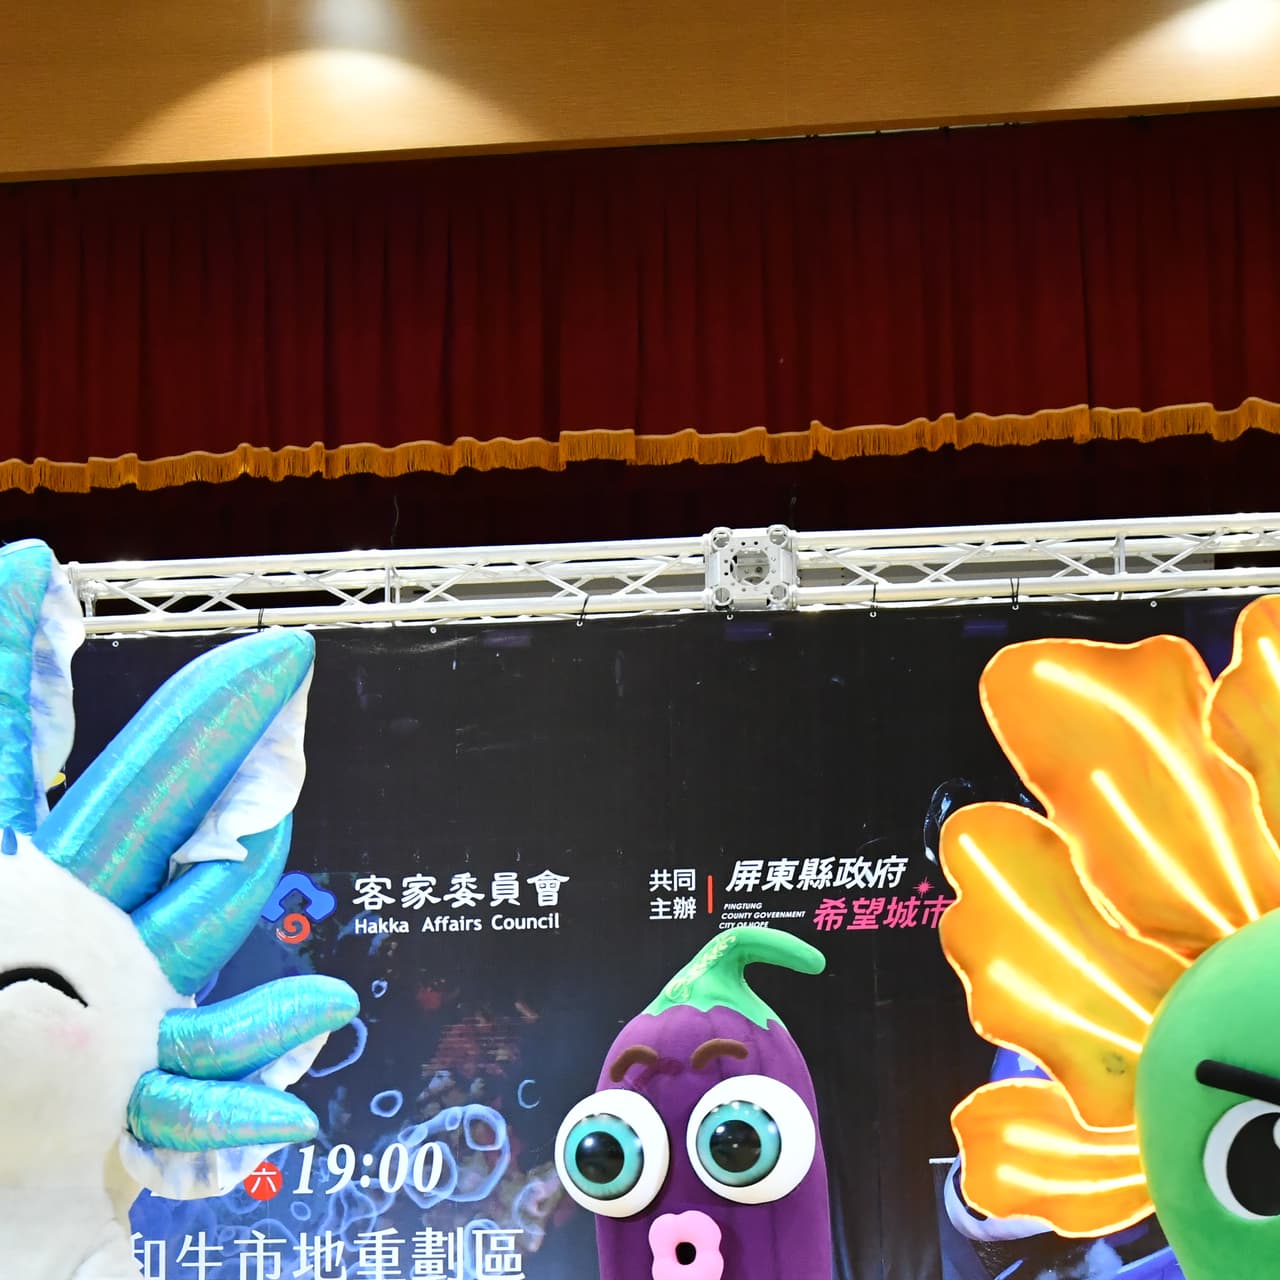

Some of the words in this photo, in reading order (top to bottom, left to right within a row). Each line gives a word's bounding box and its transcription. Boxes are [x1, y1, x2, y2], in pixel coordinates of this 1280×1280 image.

[648, 868, 697, 893] 共同
[725, 855, 909, 892] 屏東縣政府
[352, 869, 570, 911] 客家委員會
[648, 897, 697, 921] 主辦
[721, 911, 753, 920] COUNTY
[753, 910, 807, 919] GOVERNMENT
[723, 902, 763, 911] PINGTUNG
[354, 918, 410, 935] Hakka
[421, 915, 483, 933] Affairs
[490, 912, 561, 931] Council
[718, 921, 736, 930] CITY
[292, 1141, 443, 1195] 19:00
